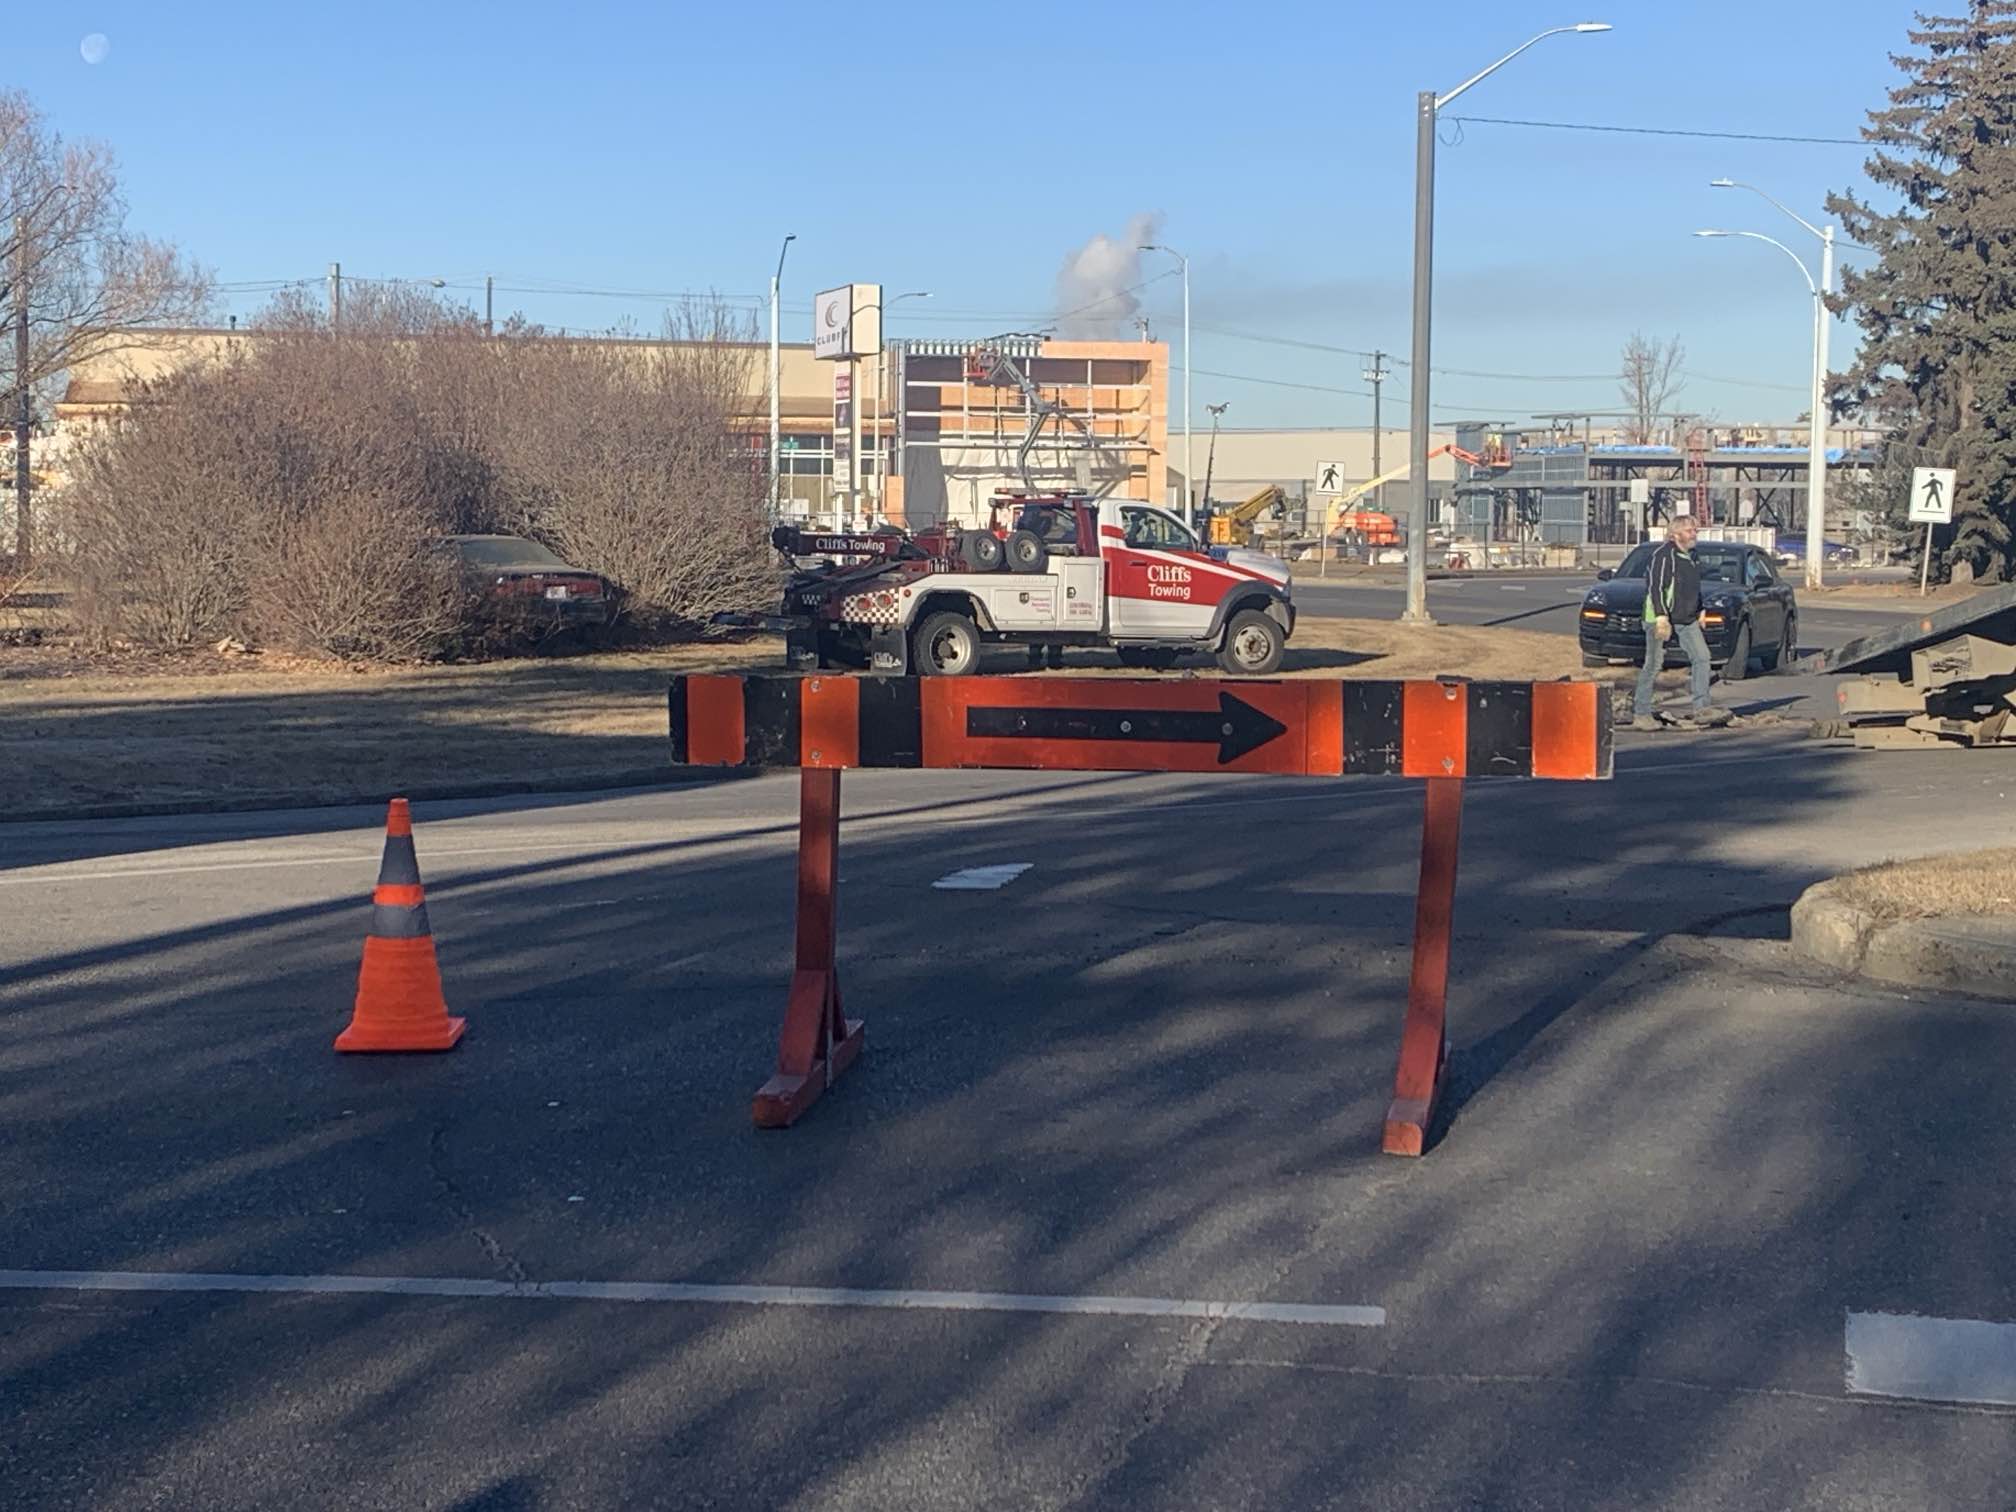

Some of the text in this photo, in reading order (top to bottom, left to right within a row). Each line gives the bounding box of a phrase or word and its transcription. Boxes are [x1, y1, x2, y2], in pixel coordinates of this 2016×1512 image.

[815, 538, 885, 552] Cliffs Towing
[1147, 565, 1192, 582] Cliffs
[1148, 583, 1190, 600] Towing
